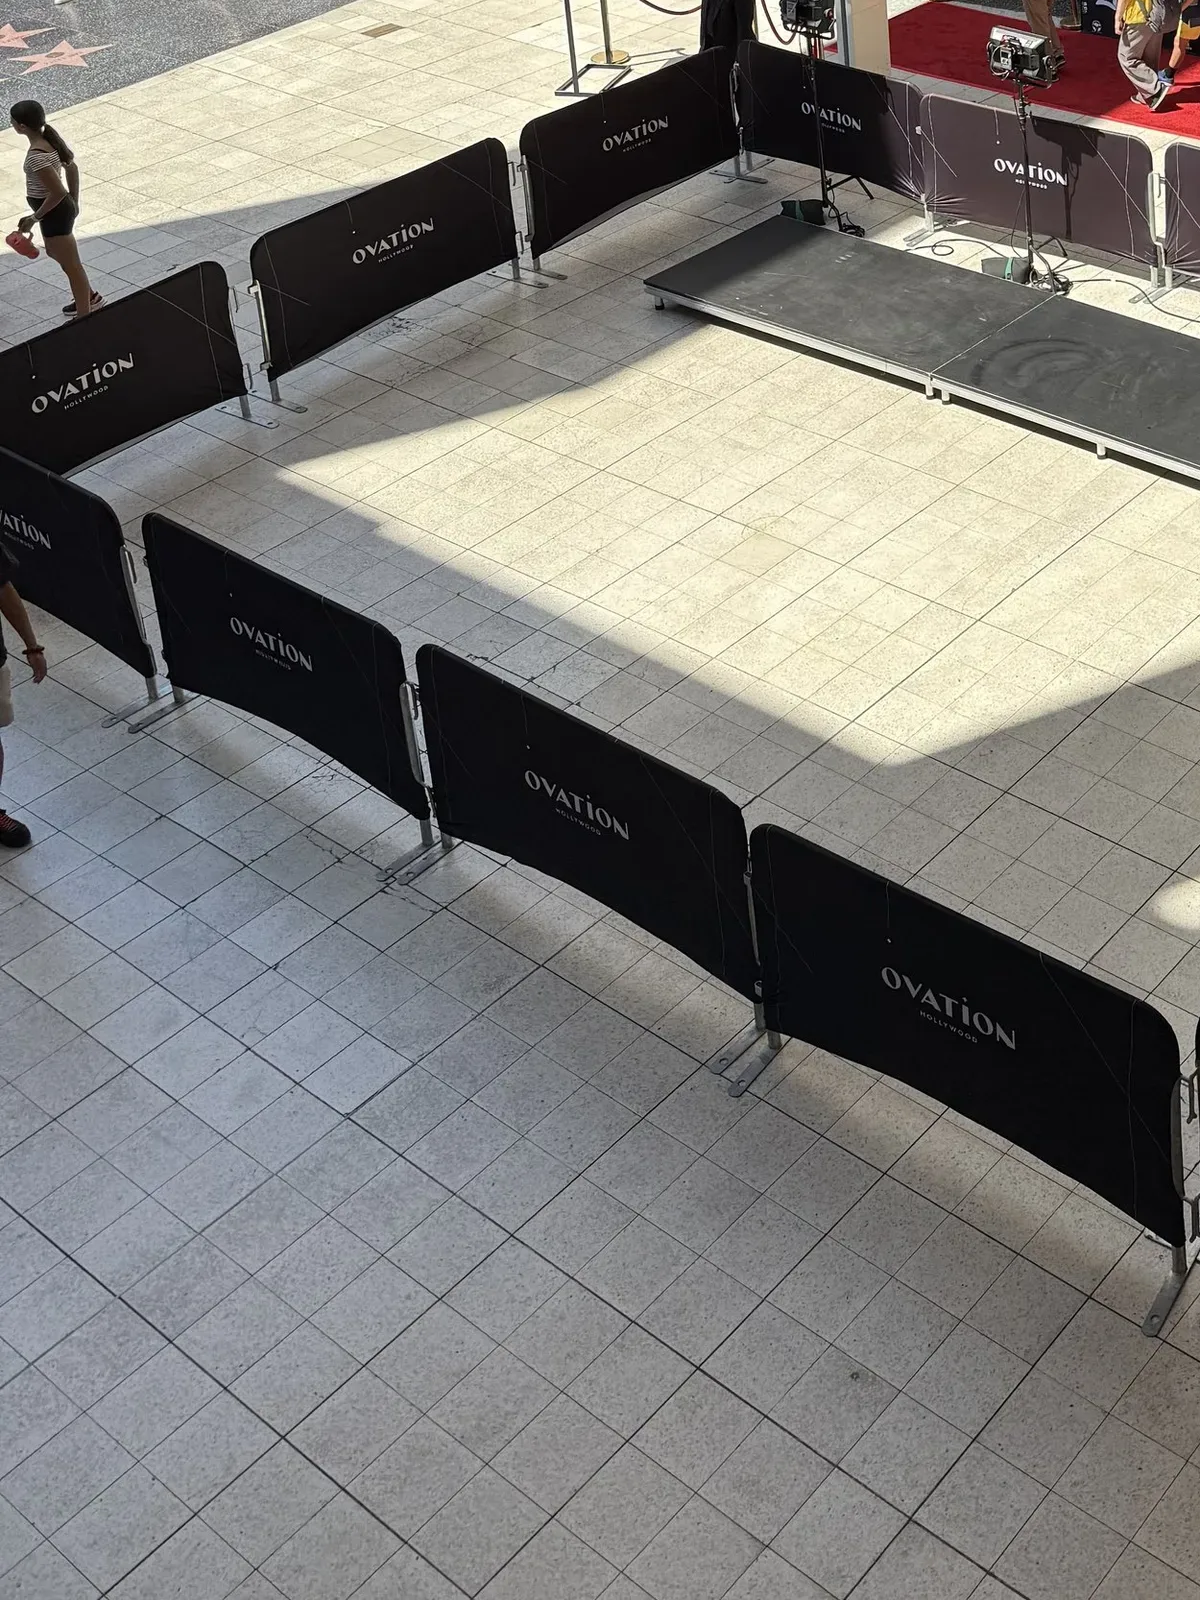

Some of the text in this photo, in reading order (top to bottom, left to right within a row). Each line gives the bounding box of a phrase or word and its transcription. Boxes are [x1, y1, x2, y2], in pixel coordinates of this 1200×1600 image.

[64, 385, 109, 410] HOLLYWOOD
[555, 808, 601, 836] HOLLYWOOD
[920, 1010, 978, 1043] HOLLYWOOD
